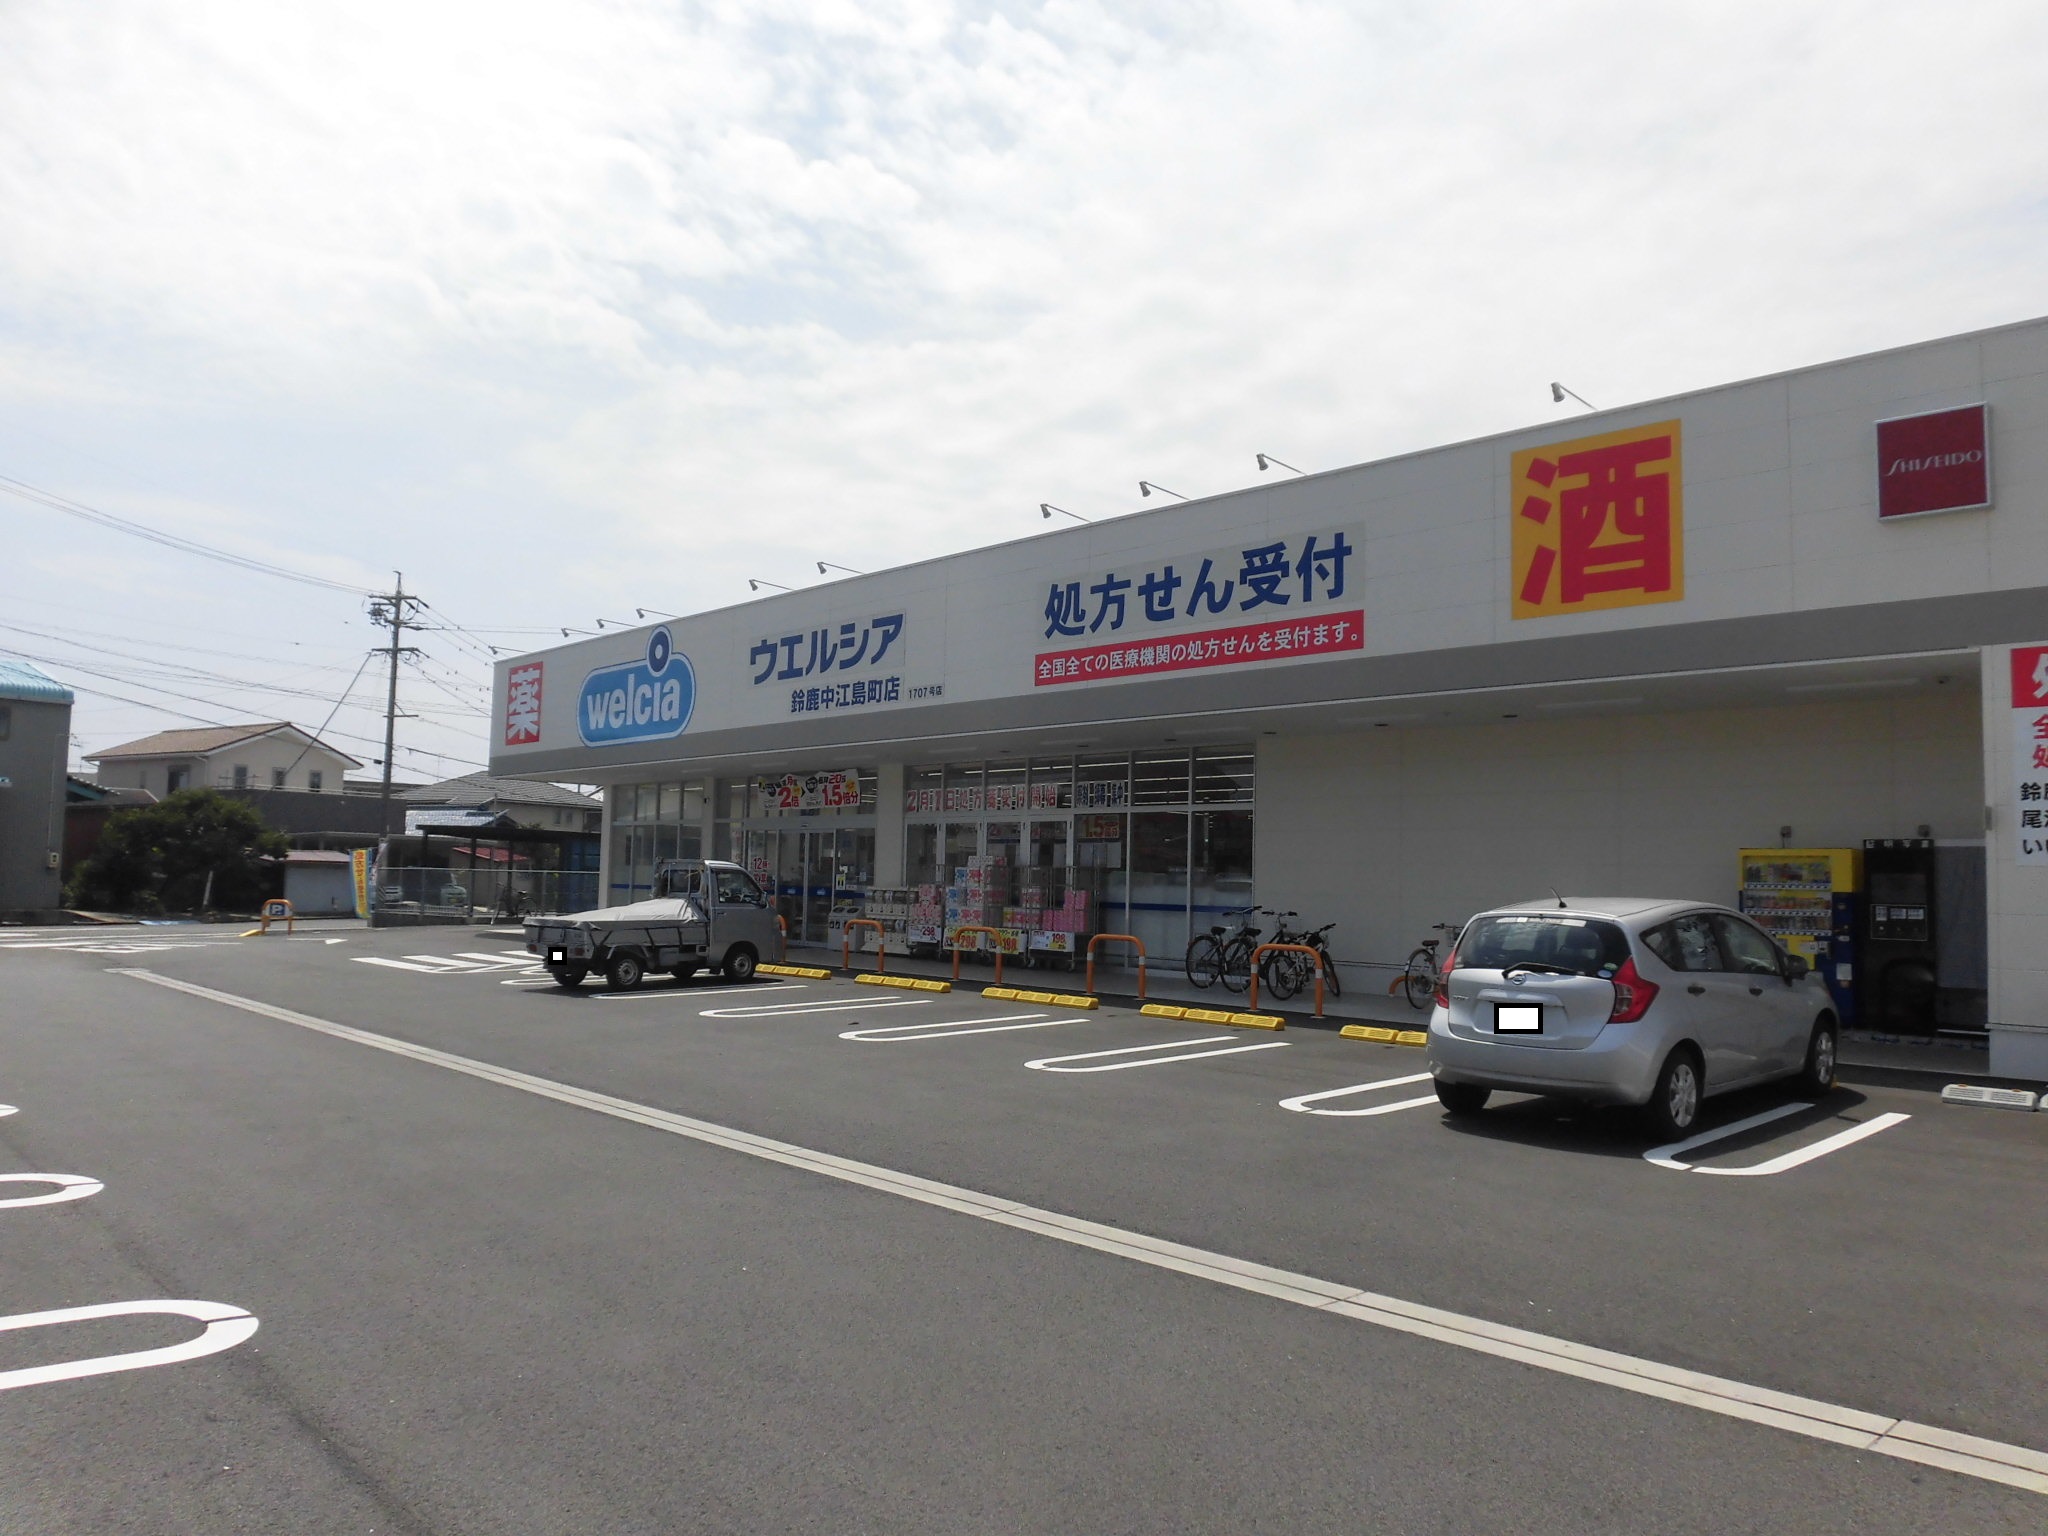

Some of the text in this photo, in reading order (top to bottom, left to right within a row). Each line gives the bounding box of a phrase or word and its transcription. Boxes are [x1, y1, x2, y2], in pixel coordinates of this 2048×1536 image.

[1887, 449, 1982, 477] SHISEIDO
[1519, 434, 1672, 606] 酒
[1043, 531, 1353, 639] 処方せん受付
[749, 613, 904, 685] ウエルシア
[1038, 621, 1359, 680] 全国全ての医療機関の処方せんを受付ます。
[506, 668, 541, 740] 薬
[586, 673, 681, 730] welcia
[790, 676, 900, 713] 鈴鹿中江島町店
[907, 685, 944, 700] 1707号店
[2020, 782, 2048, 803] 鈴
